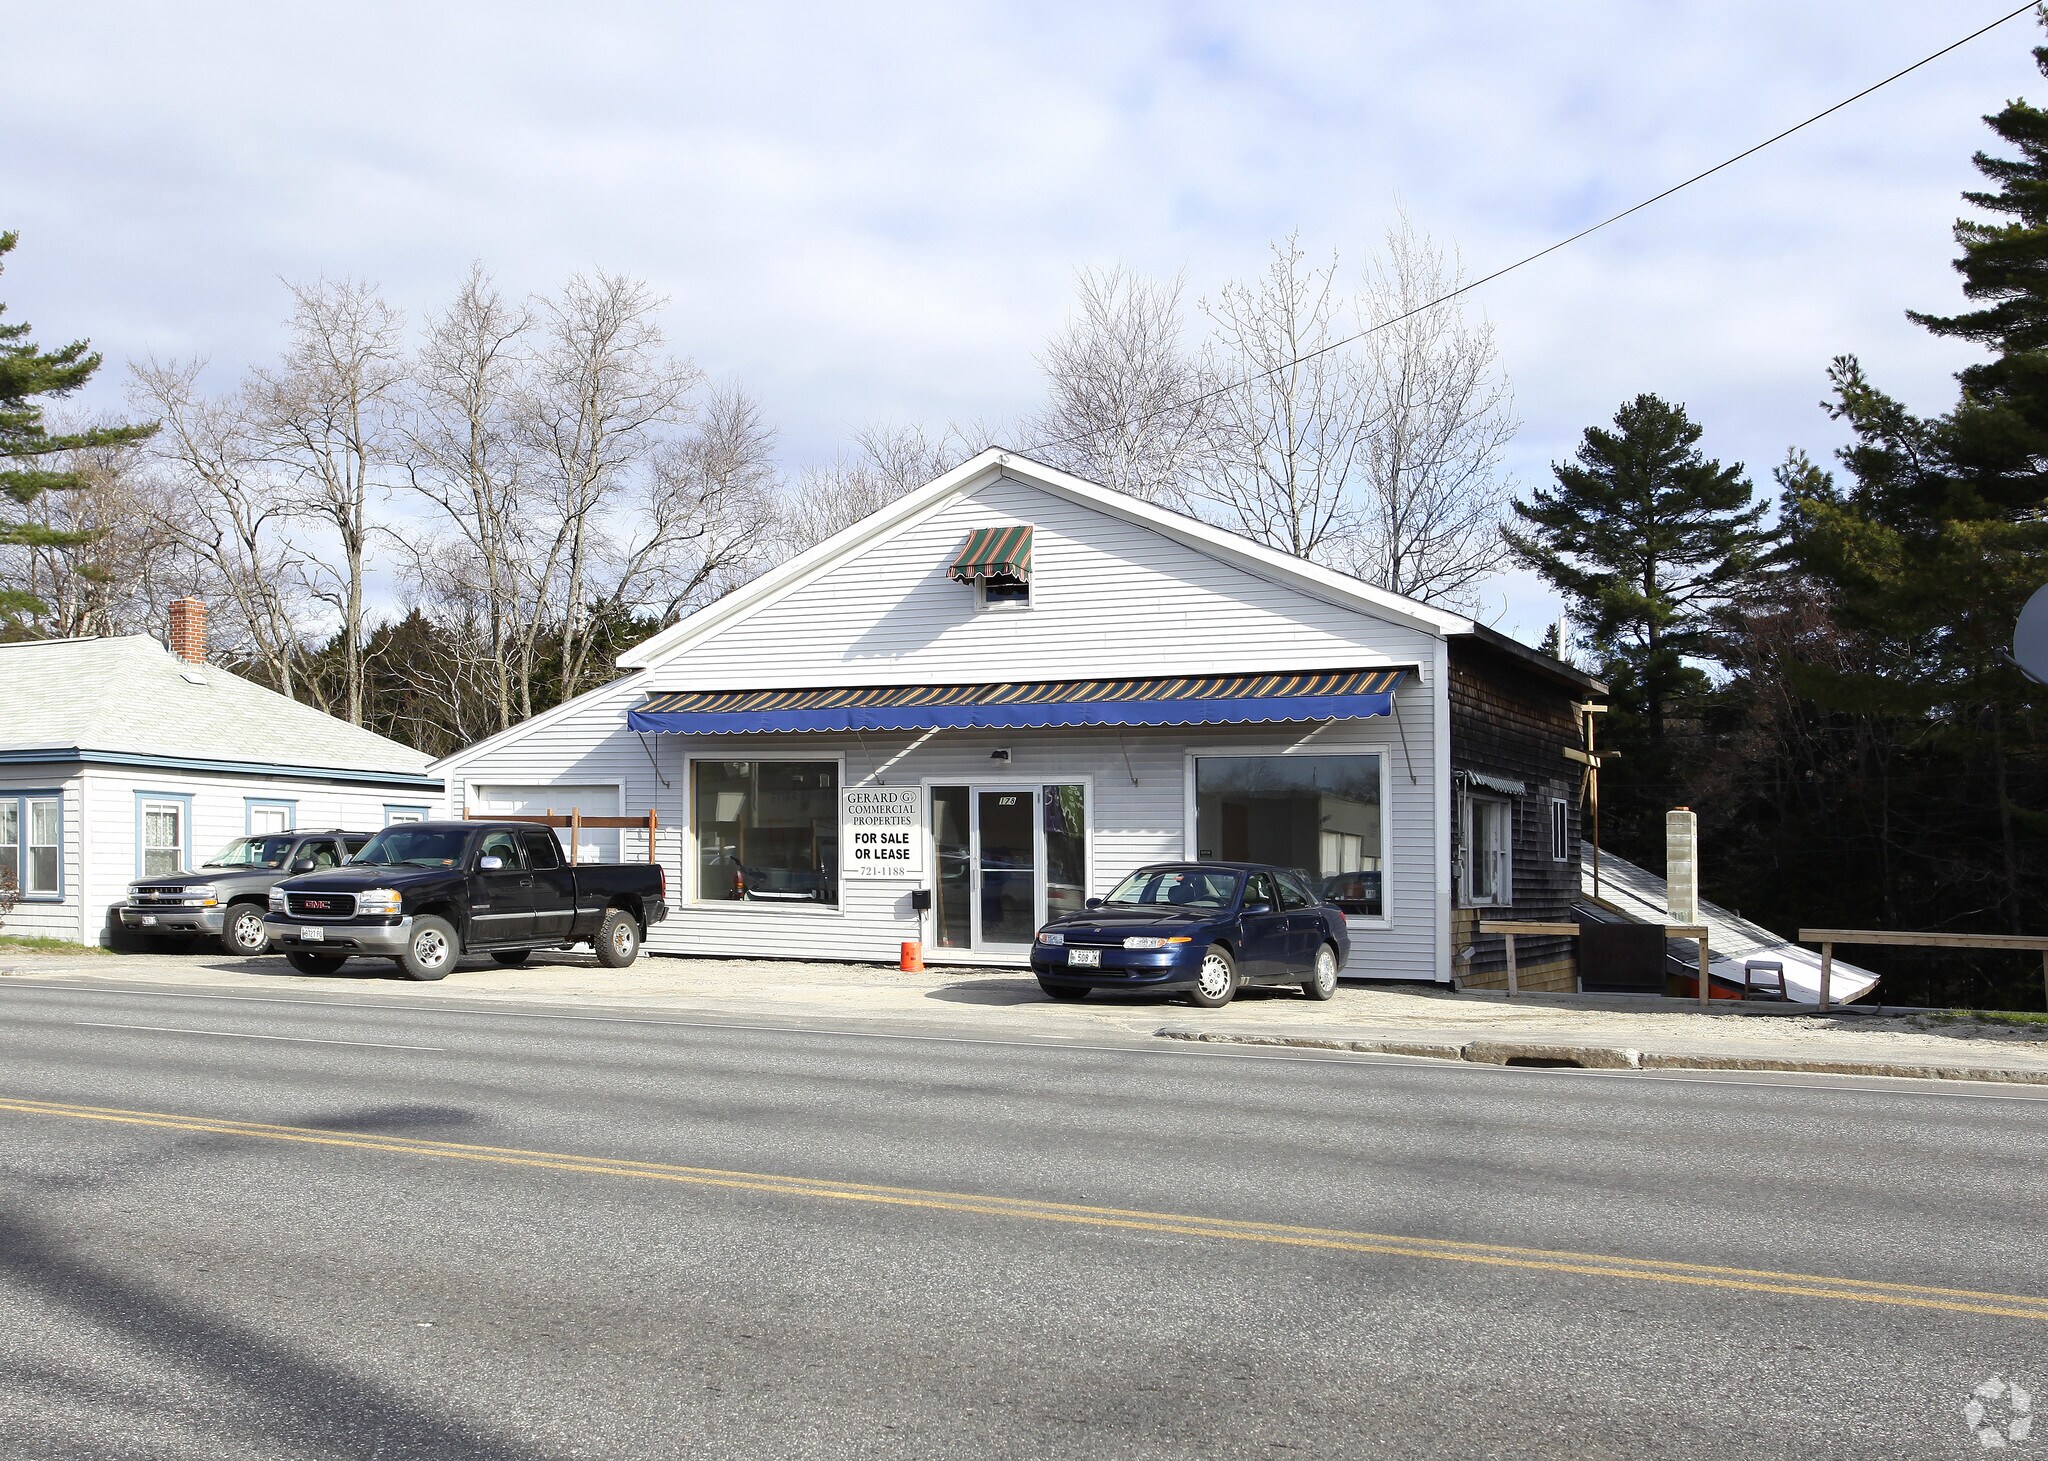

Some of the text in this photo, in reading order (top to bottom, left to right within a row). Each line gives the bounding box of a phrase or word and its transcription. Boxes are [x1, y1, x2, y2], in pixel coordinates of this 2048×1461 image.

[847, 792, 898, 803] GERARD
[848, 804, 916, 814] COMMERCIAL
[853, 816, 912, 826] PROPERTIES
[855, 833, 909, 844] FOR SALE
[855, 849, 910, 860] OR LEASE
[860, 866, 905, 876] 721-1188
[304, 900, 331, 909] GMC
